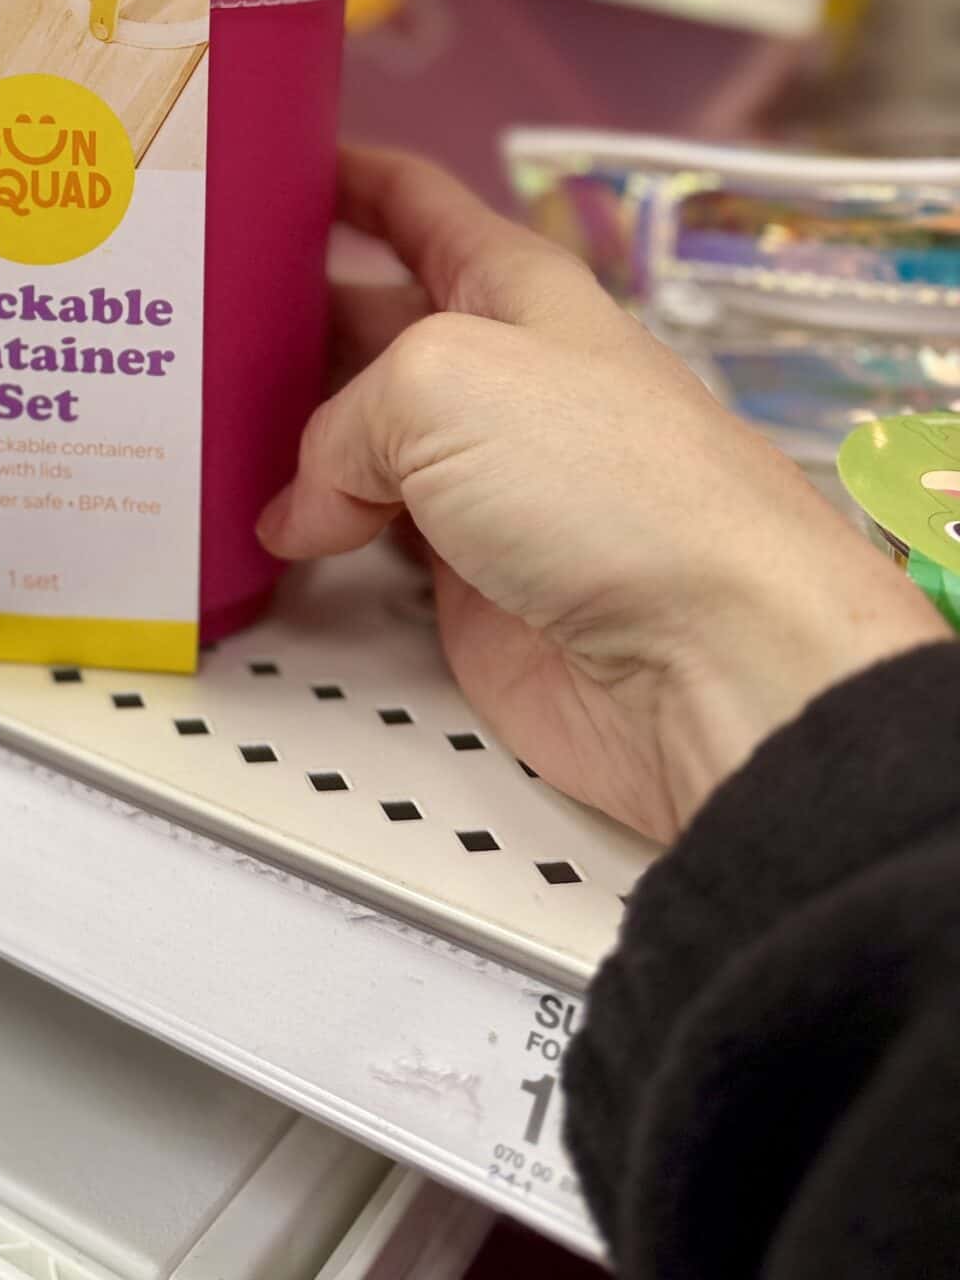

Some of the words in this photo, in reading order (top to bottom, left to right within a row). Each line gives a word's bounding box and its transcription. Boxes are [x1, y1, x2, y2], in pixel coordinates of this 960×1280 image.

[61, 440, 166, 461] containers
[39, 462, 73, 481] lids
[22, 492, 64, 511] safe
[78, 495, 119, 513] BPA
[121, 496, 162, 516] free
[8, 570, 18, 592] 1
[21, 573, 60, 593] set
[520, 1074, 555, 1145] 1
[493, 1143, 526, 1169] 070
